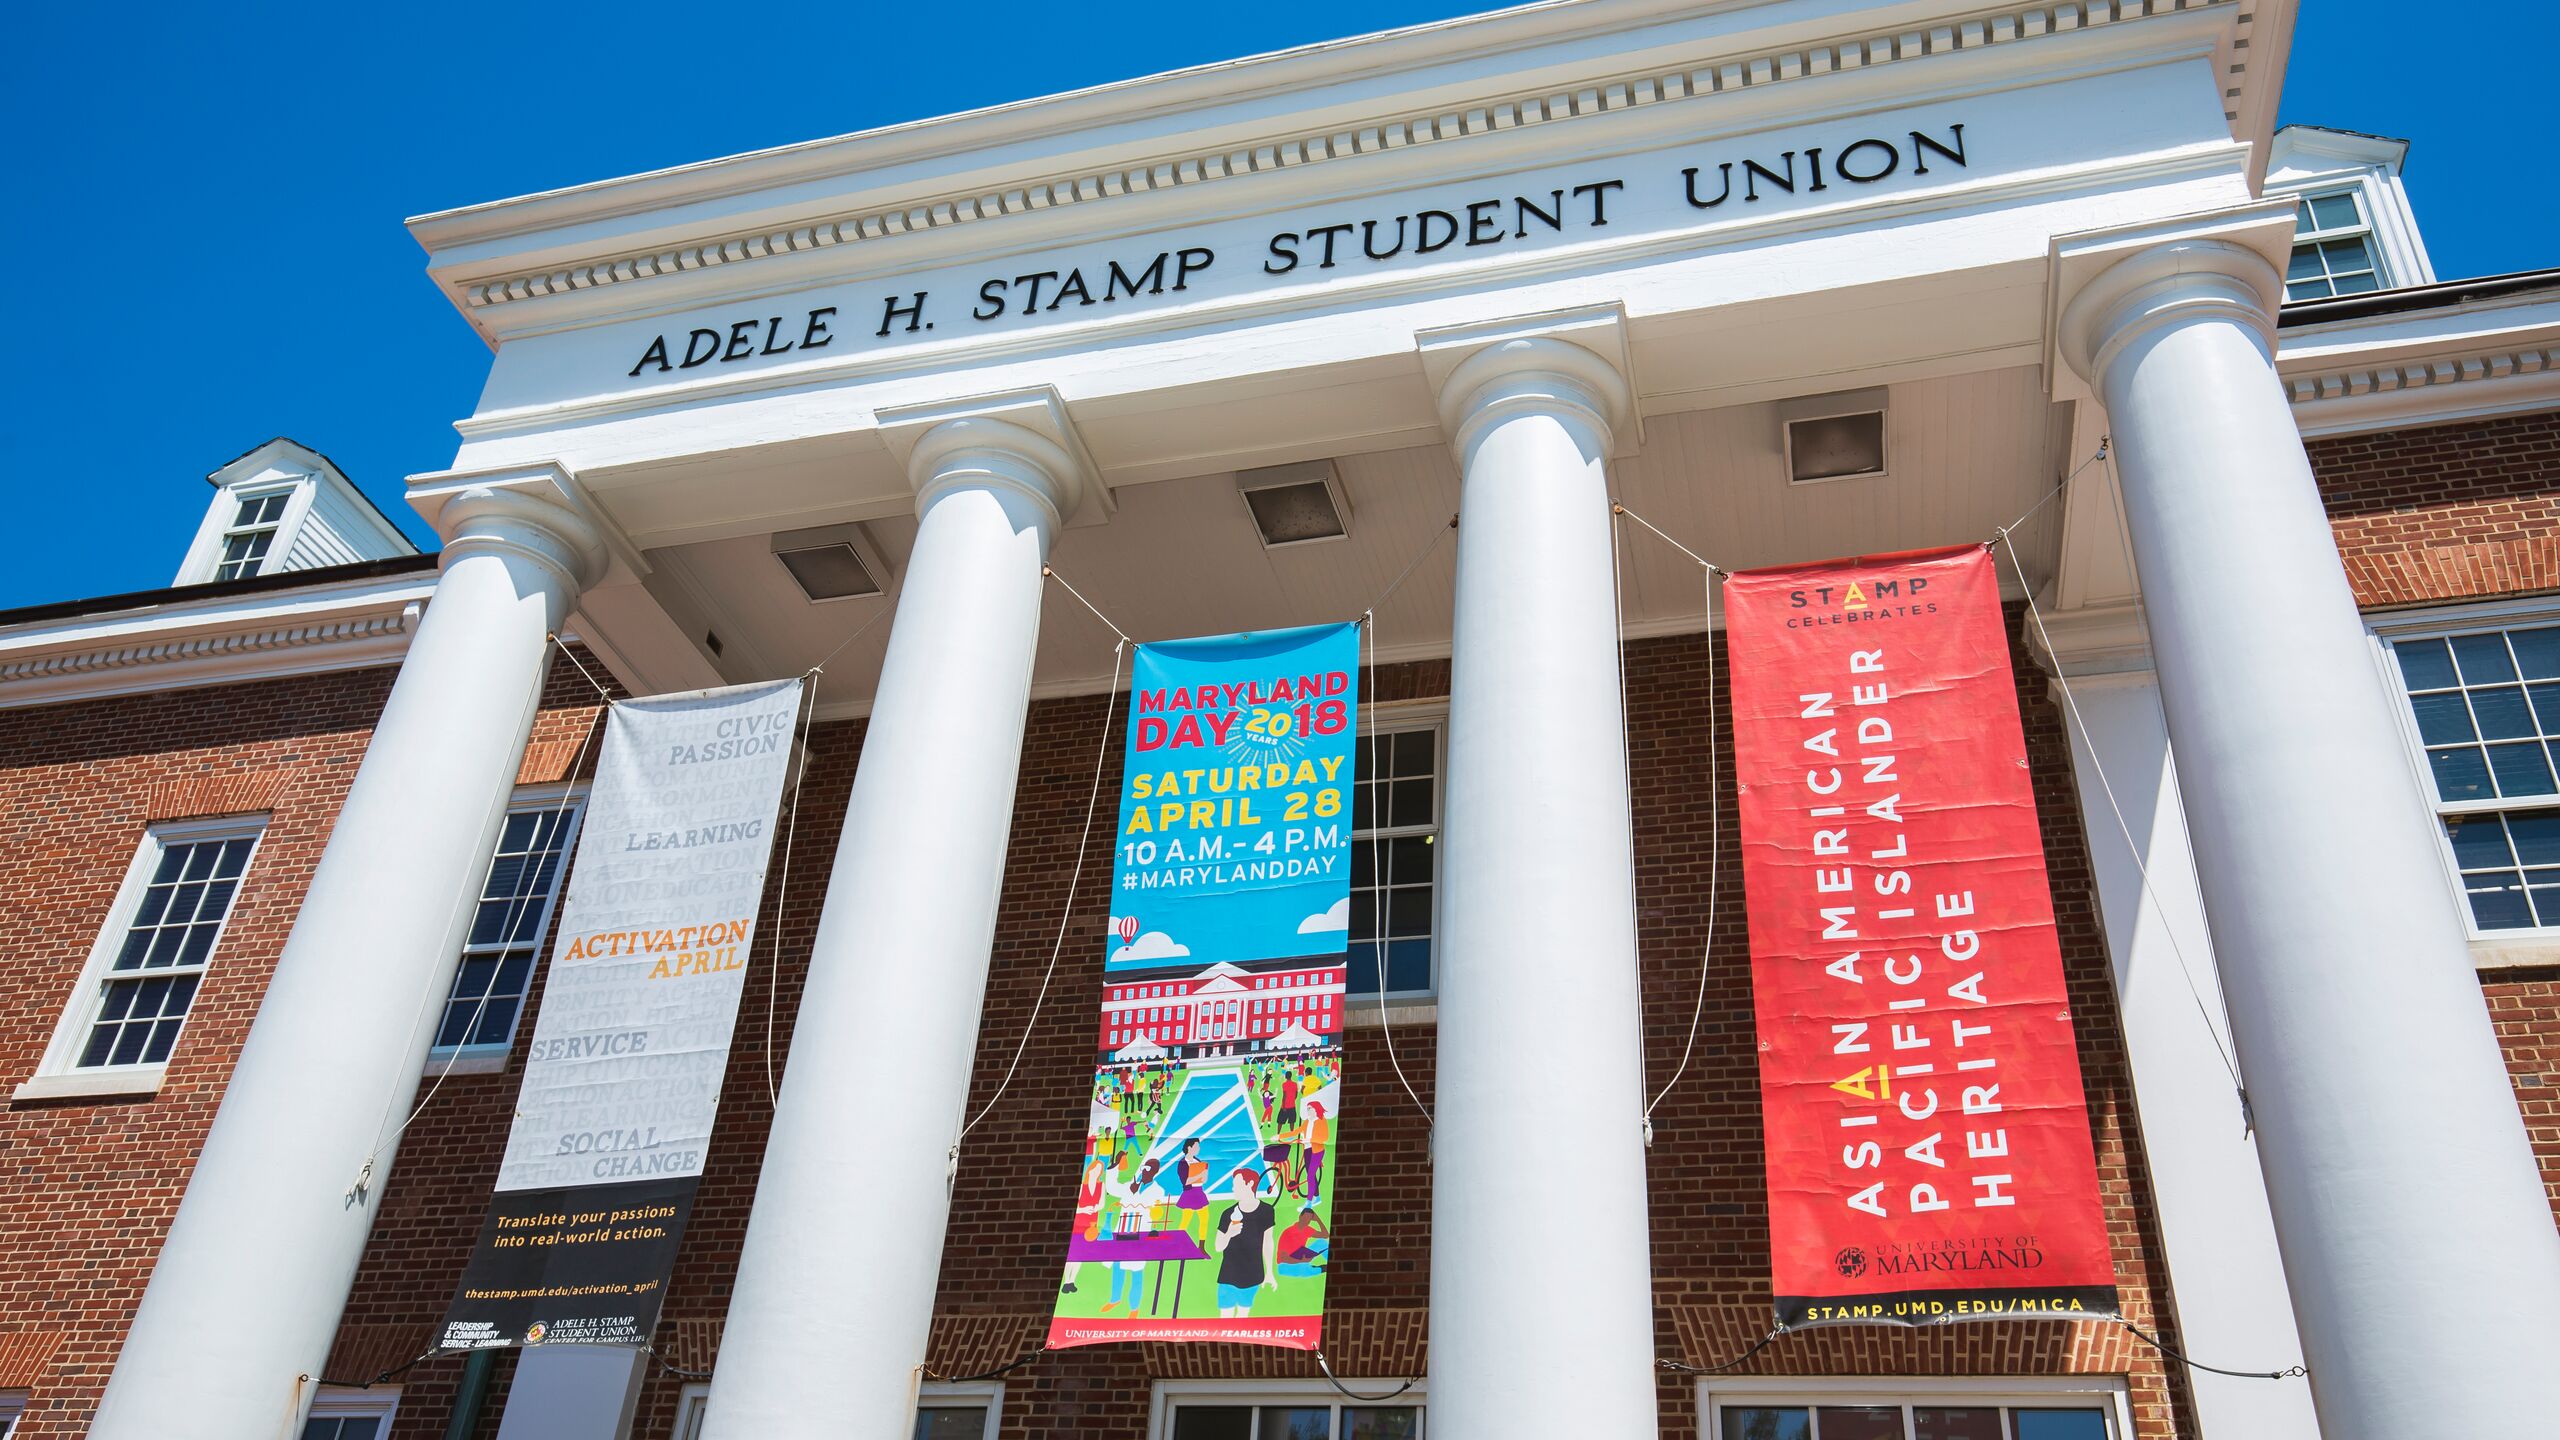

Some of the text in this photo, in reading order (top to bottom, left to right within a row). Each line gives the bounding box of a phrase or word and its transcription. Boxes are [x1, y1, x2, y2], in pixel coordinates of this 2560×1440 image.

[628, 123, 1969, 378] ADELE H. STAMP STUDENT UNION
[1790, 577, 1928, 610] STAMP
[1786, 603, 1938, 629] CELEBRATES
[1138, 671, 1349, 714] MARYLAND
[715, 710, 789, 740] CIVIC
[1135, 711, 1240, 752] DAY
[1246, 732, 1279, 746] YEARS
[668, 733, 780, 766] PASSION
[1131, 755, 1345, 799] SATURDAY
[1126, 788, 1342, 835] APRIL 28
[624, 818, 763, 852] LEARNING
[1123, 841, 1157, 866] 10
[1285, 824, 1347, 853] P.M.
[1122, 855, 1337, 890] #MARYLANDDAY
[563, 918, 750, 960] ACTIVATION
[1850, 648, 1950, 1213] PACIFIC ISLANDER
[648, 945, 745, 979] APRIL
[1800, 692, 1890, 1217] ASIAN AMERICAN
[530, 1032, 648, 1062] SERVICE
[1935, 890, 2015, 1207] HERITAGE
[556, 1126, 661, 1156] SOCIAL
[592, 1150, 698, 1179] CHANGE
[496, 1204, 676, 1229] Translate your passions
[494, 1225, 667, 1248] into real-world action.
[1875, 1235, 2039, 1255] UNIVERSITY OF
[1876, 1247, 2043, 1276] MARYLAND
[464, 1279, 659, 1301] thestamp.umd.edu/activation_april
[552, 1316, 635, 1329] ADELE H. STAMP
[1806, 1297, 2085, 1321] STAMP.UMD.EDU/MICA
[448, 1321, 494, 1331] LEADERSHIP
[452, 1330, 500, 1339] COMMUNITY
[548, 1328, 599, 1338] STUDENT
[600, 1325, 638, 1336] UNION
[596, 1335, 629, 1343] CAMPUS
[1065, 1329, 1129, 1338] UNIVERSITY
[1131, 1330, 1147, 1338] OF
[1146, 1329, 1209, 1338] MARYLAND
[1220, 1329, 1272, 1338] FEARLESS
[1274, 1329, 1305, 1338] IDEAS
